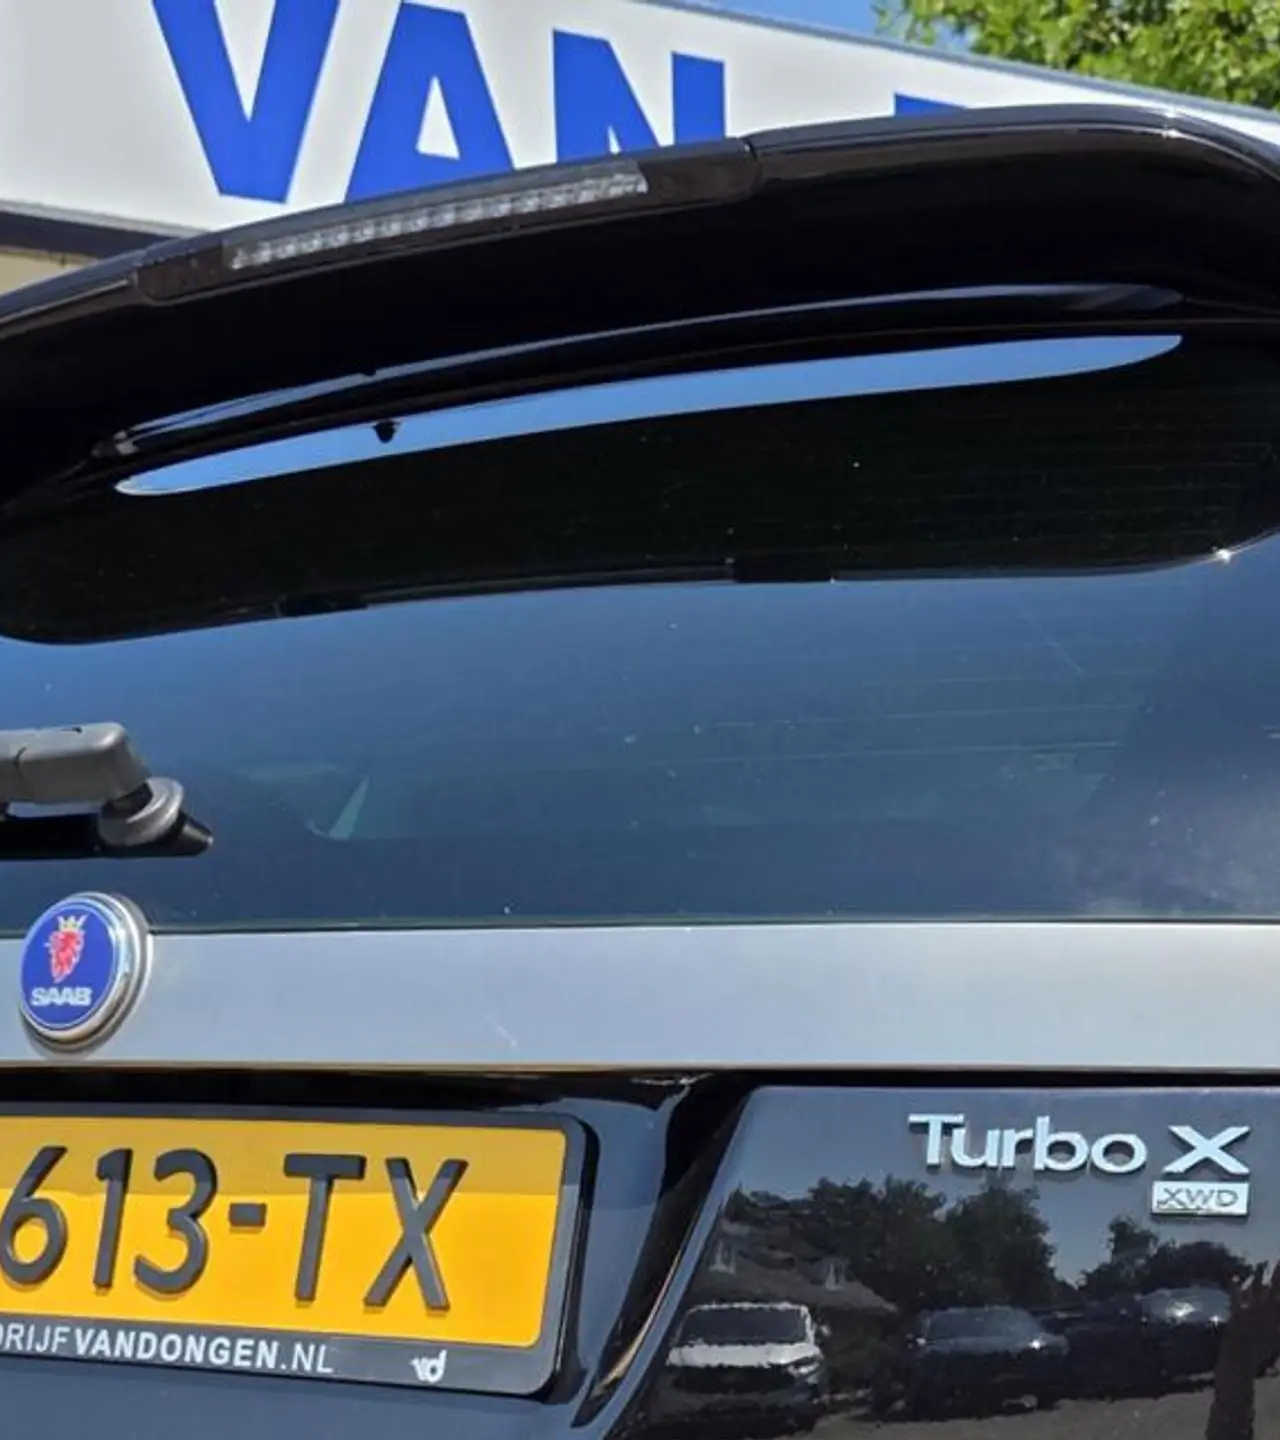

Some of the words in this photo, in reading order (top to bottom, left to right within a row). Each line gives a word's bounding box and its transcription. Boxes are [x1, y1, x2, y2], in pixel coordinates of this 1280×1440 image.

[31, 987, 93, 1007] SAAB
[908, 1113, 1148, 1174] Turbo
[1162, 1125, 1251, 1175] X
